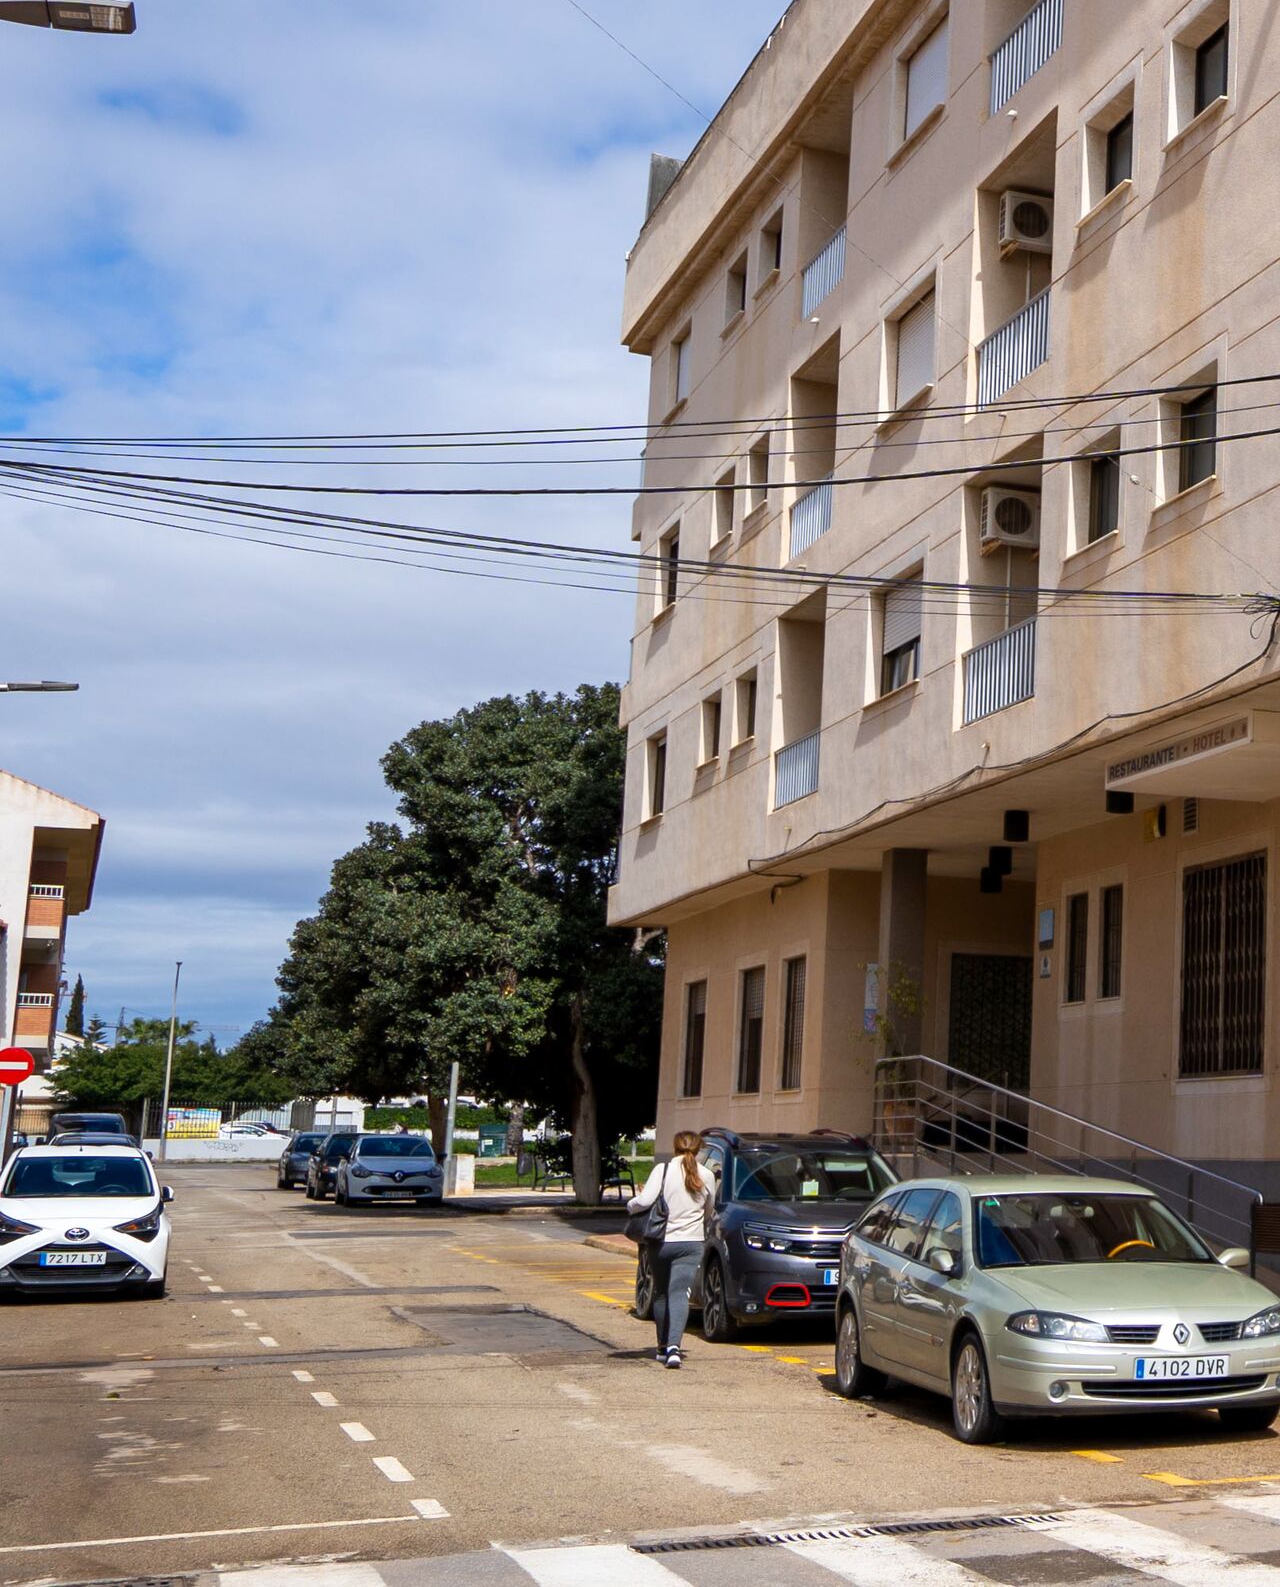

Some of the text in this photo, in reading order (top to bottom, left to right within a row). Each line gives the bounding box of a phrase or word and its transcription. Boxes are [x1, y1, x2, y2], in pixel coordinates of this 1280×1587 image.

[1109, 730, 1226, 779] RESTAURANTE HOTEL
[49, 1253, 103, 1264] 7217 LTX
[1149, 1359, 1225, 1376] 4102 DVR
